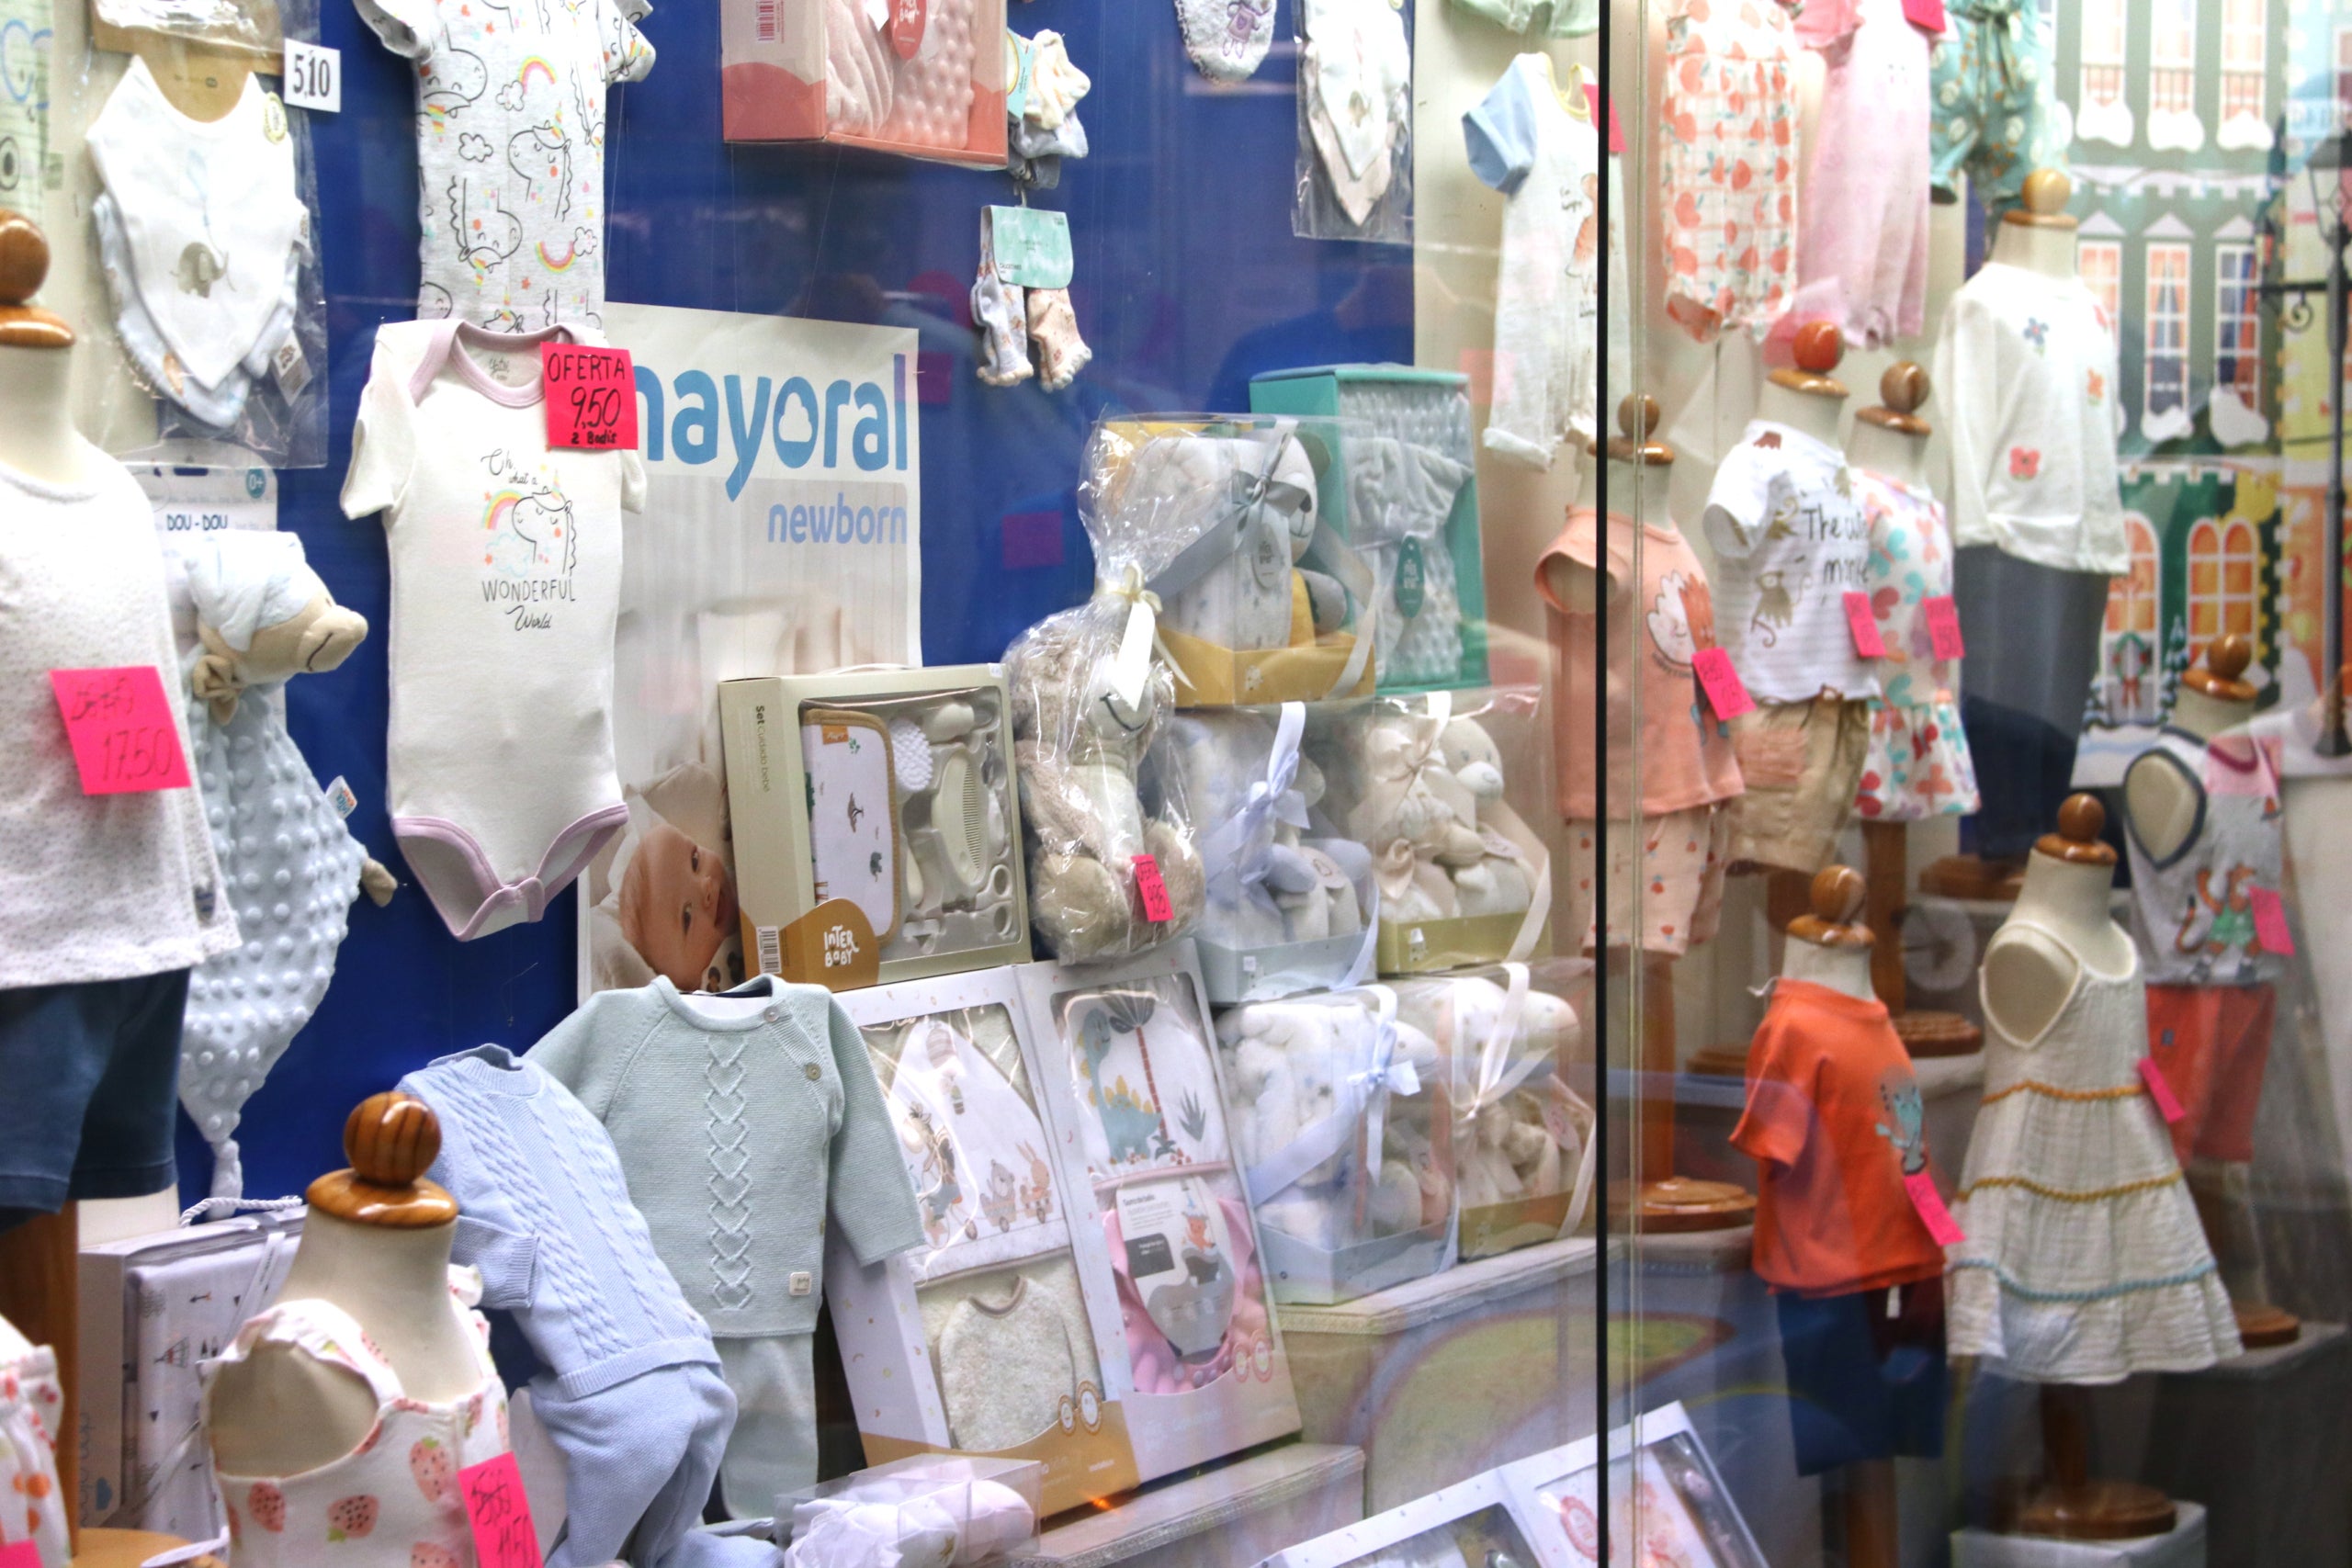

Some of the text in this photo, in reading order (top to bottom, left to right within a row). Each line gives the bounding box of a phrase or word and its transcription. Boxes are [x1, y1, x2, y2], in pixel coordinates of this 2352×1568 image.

[548, 353, 625, 382] OFERTA
[571, 386, 621, 429] 9,50
[571, 432, 580, 444] 2
[166, 514, 192, 531] DOU
[202, 514, 228, 531] DOU
[768, 491, 908, 545] newborn
[1802, 503, 1840, 541] The
[481, 579, 576, 603] WONDERFUL
[505, 604, 551, 632] World
[756, 705, 764, 725] Set
